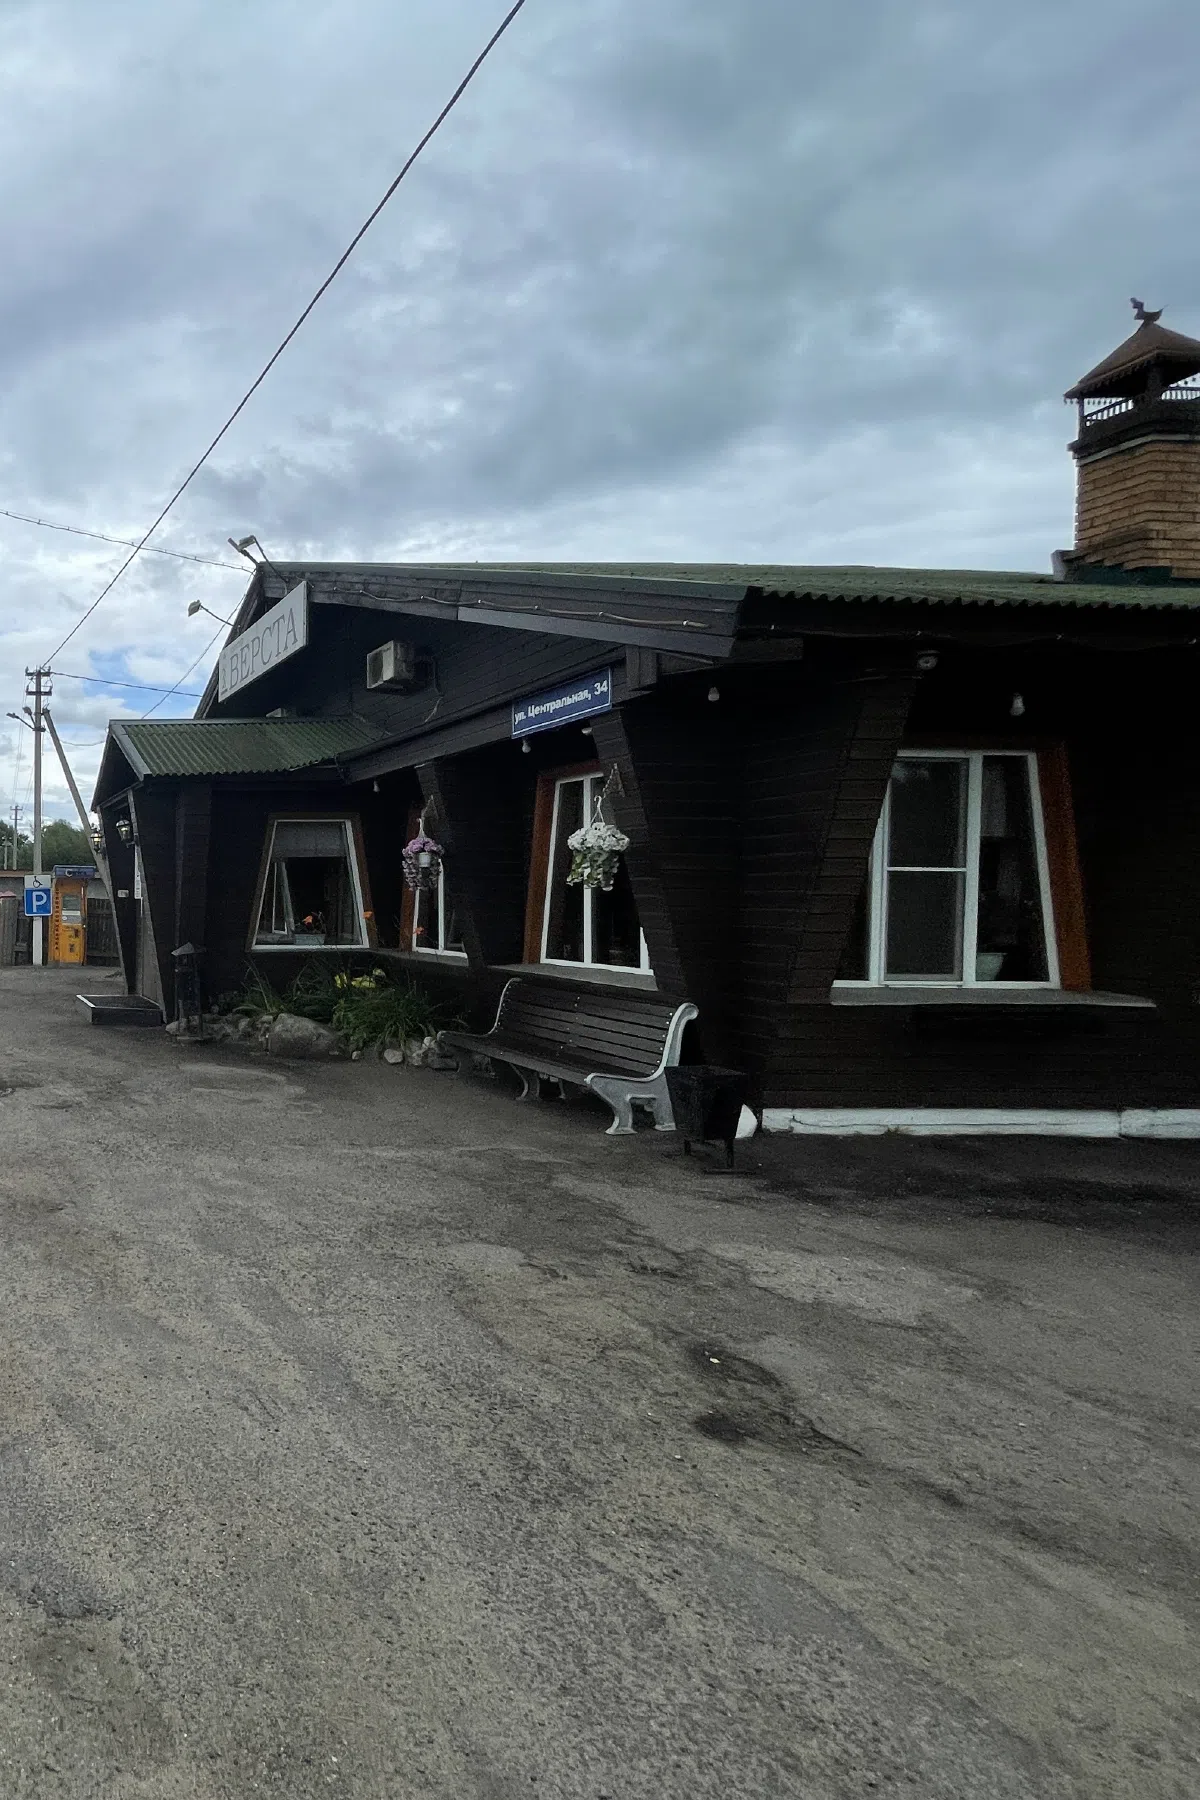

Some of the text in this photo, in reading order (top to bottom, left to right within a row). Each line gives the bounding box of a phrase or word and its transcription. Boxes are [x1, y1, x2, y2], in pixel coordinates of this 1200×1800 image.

[229, 607, 298, 690] ВЕРСТА
[515, 680, 608, 724] ул. Центральная, 34
[32, 891, 47, 913] P
